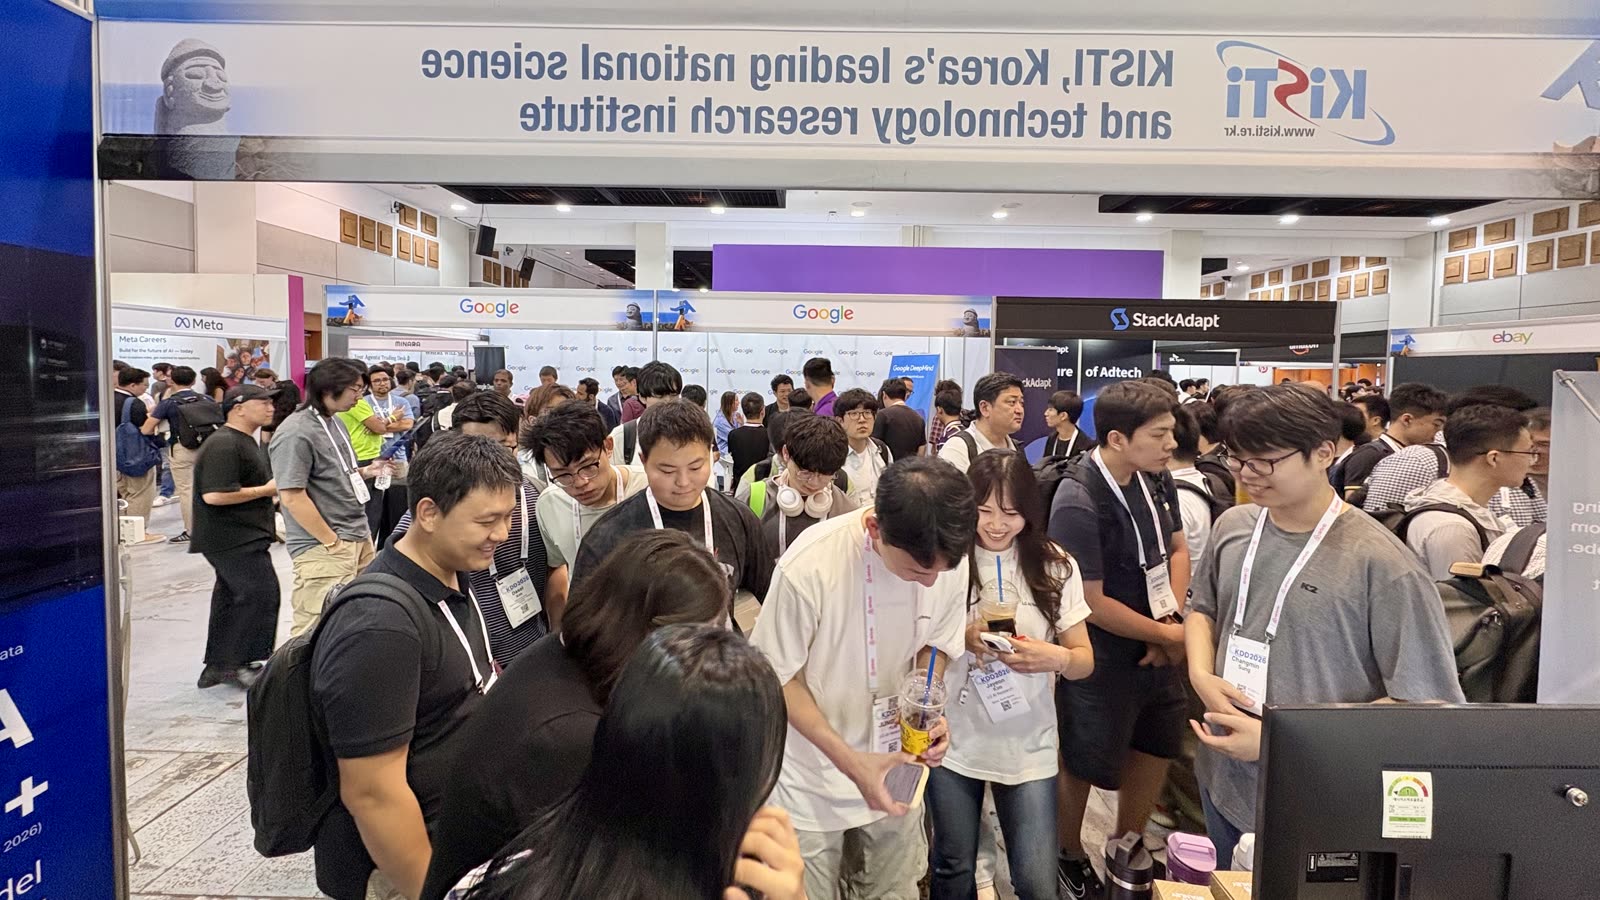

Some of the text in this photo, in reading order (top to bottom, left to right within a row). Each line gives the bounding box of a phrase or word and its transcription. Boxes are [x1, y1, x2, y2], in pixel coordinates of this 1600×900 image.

[459, 298, 519, 318] Google
[793, 304, 854, 324] Google
[192, 319, 224, 331] Meta
[1132, 312, 1220, 331] StackAdapt
[119, 335, 167, 344] Meta Careers
[1492, 331, 1533, 345] ebay
[893, 364, 934, 373] Google DeepMind
[1085, 366, 1099, 377] of
[1100, 366, 1142, 379] Adtech
[1301, 582, 1318, 594] K2
[1232, 656, 1260, 670] Changmin
[1234, 648, 1267, 664] KDD2026
[1238, 664, 1251, 674] Sung
[4, 822, 42, 853] 2026)
